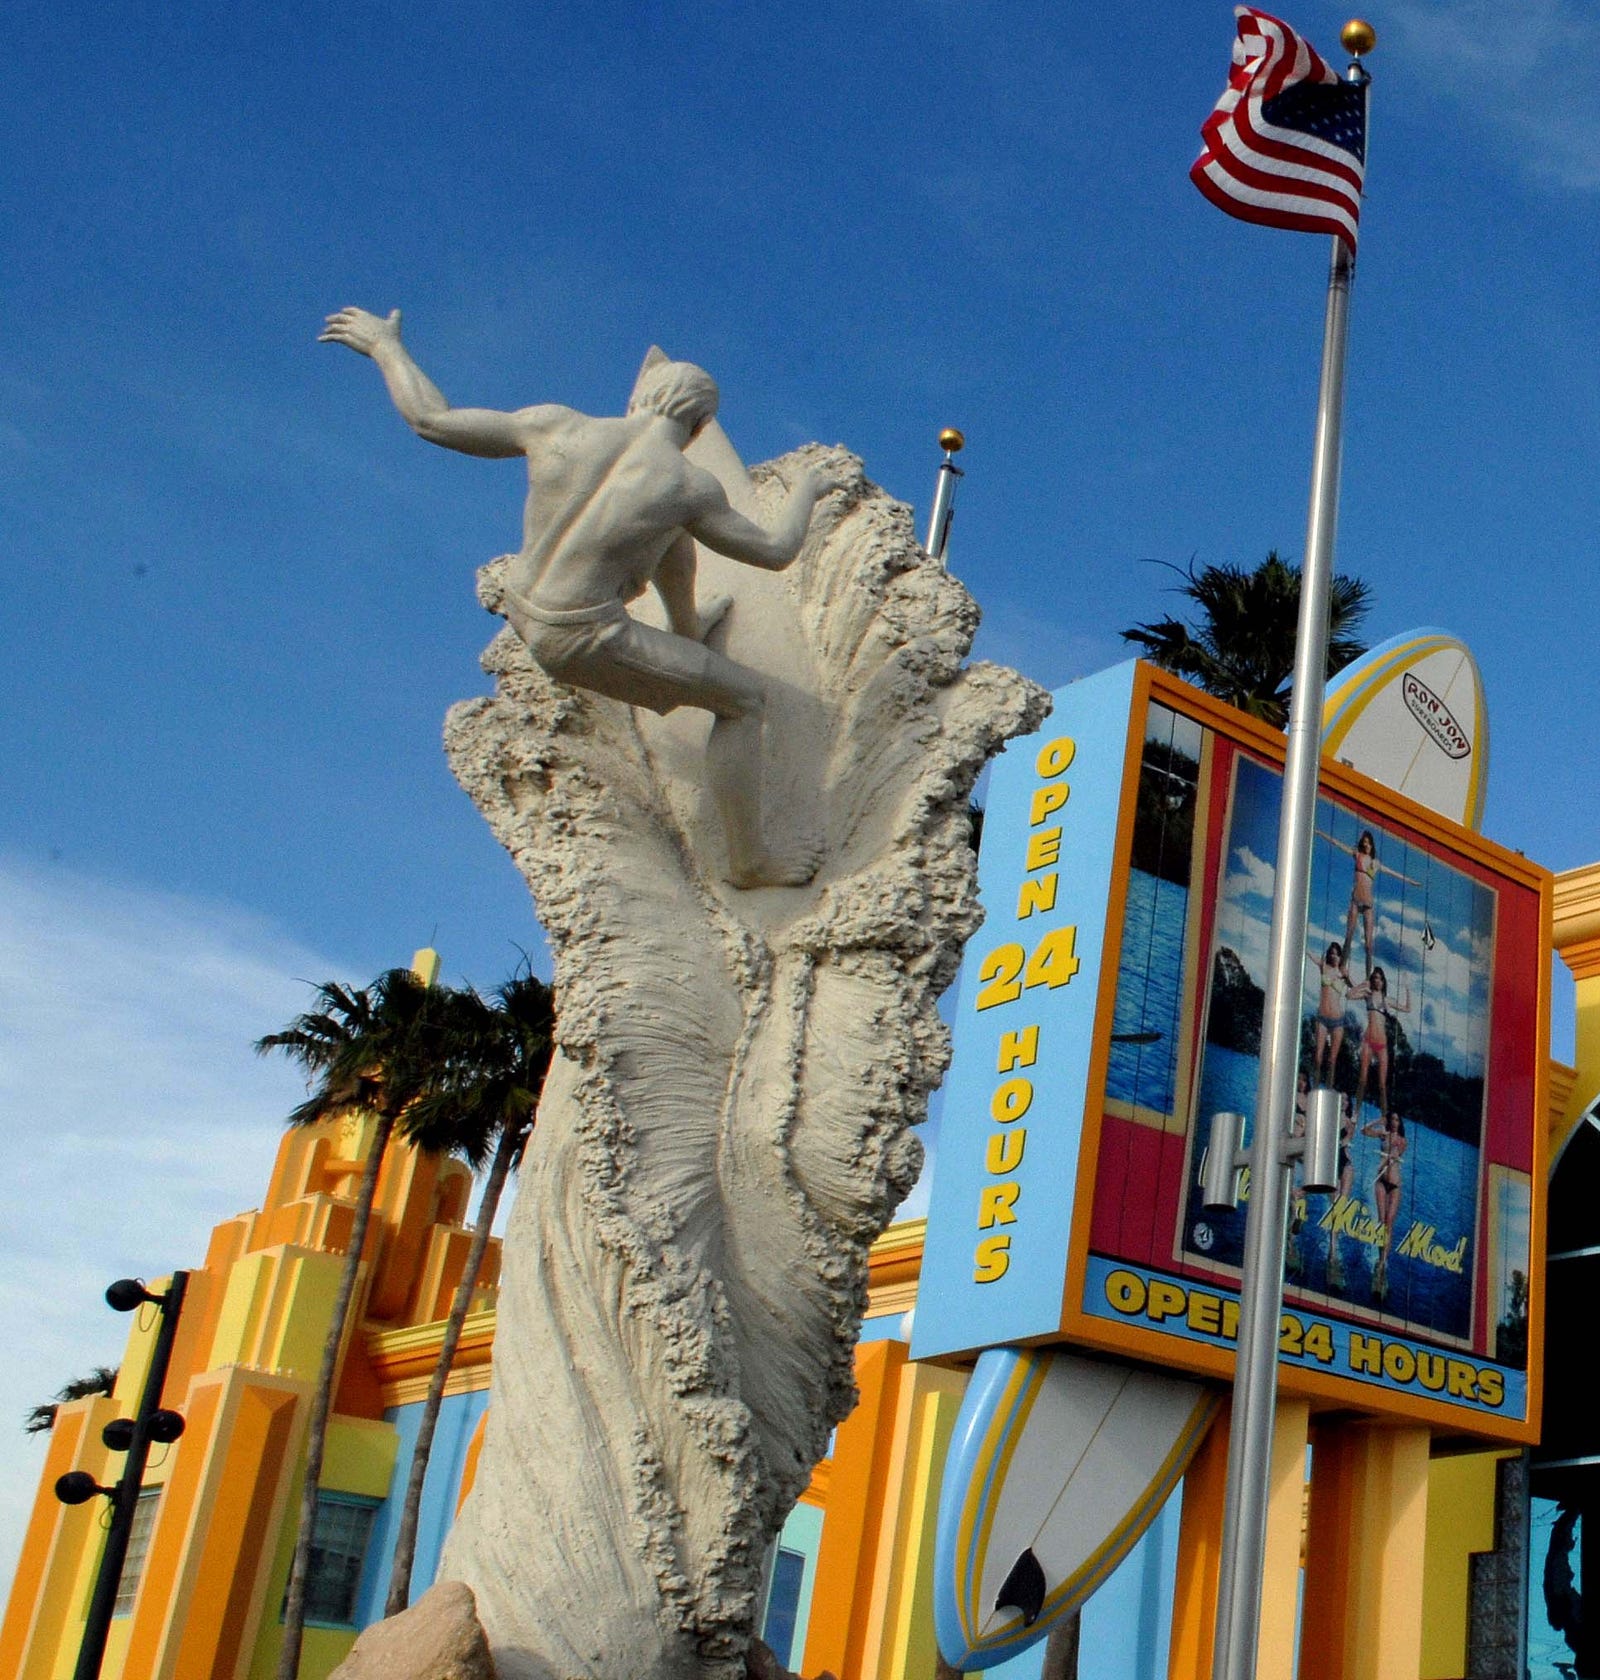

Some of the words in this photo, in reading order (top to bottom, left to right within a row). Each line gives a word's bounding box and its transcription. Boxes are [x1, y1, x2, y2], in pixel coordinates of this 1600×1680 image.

[1408, 682, 1440, 713] RON
[1438, 717, 1466, 749] JON
[1411, 699, 1453, 751] SURFBOARDS
[1017, 736, 1076, 920] OPEN
[976, 925, 1080, 1012] 24
[973, 1024, 1040, 1285] HOURS
[1279, 1313, 1335, 1364] 24
[1349, 1330, 1505, 1408] HOURS
